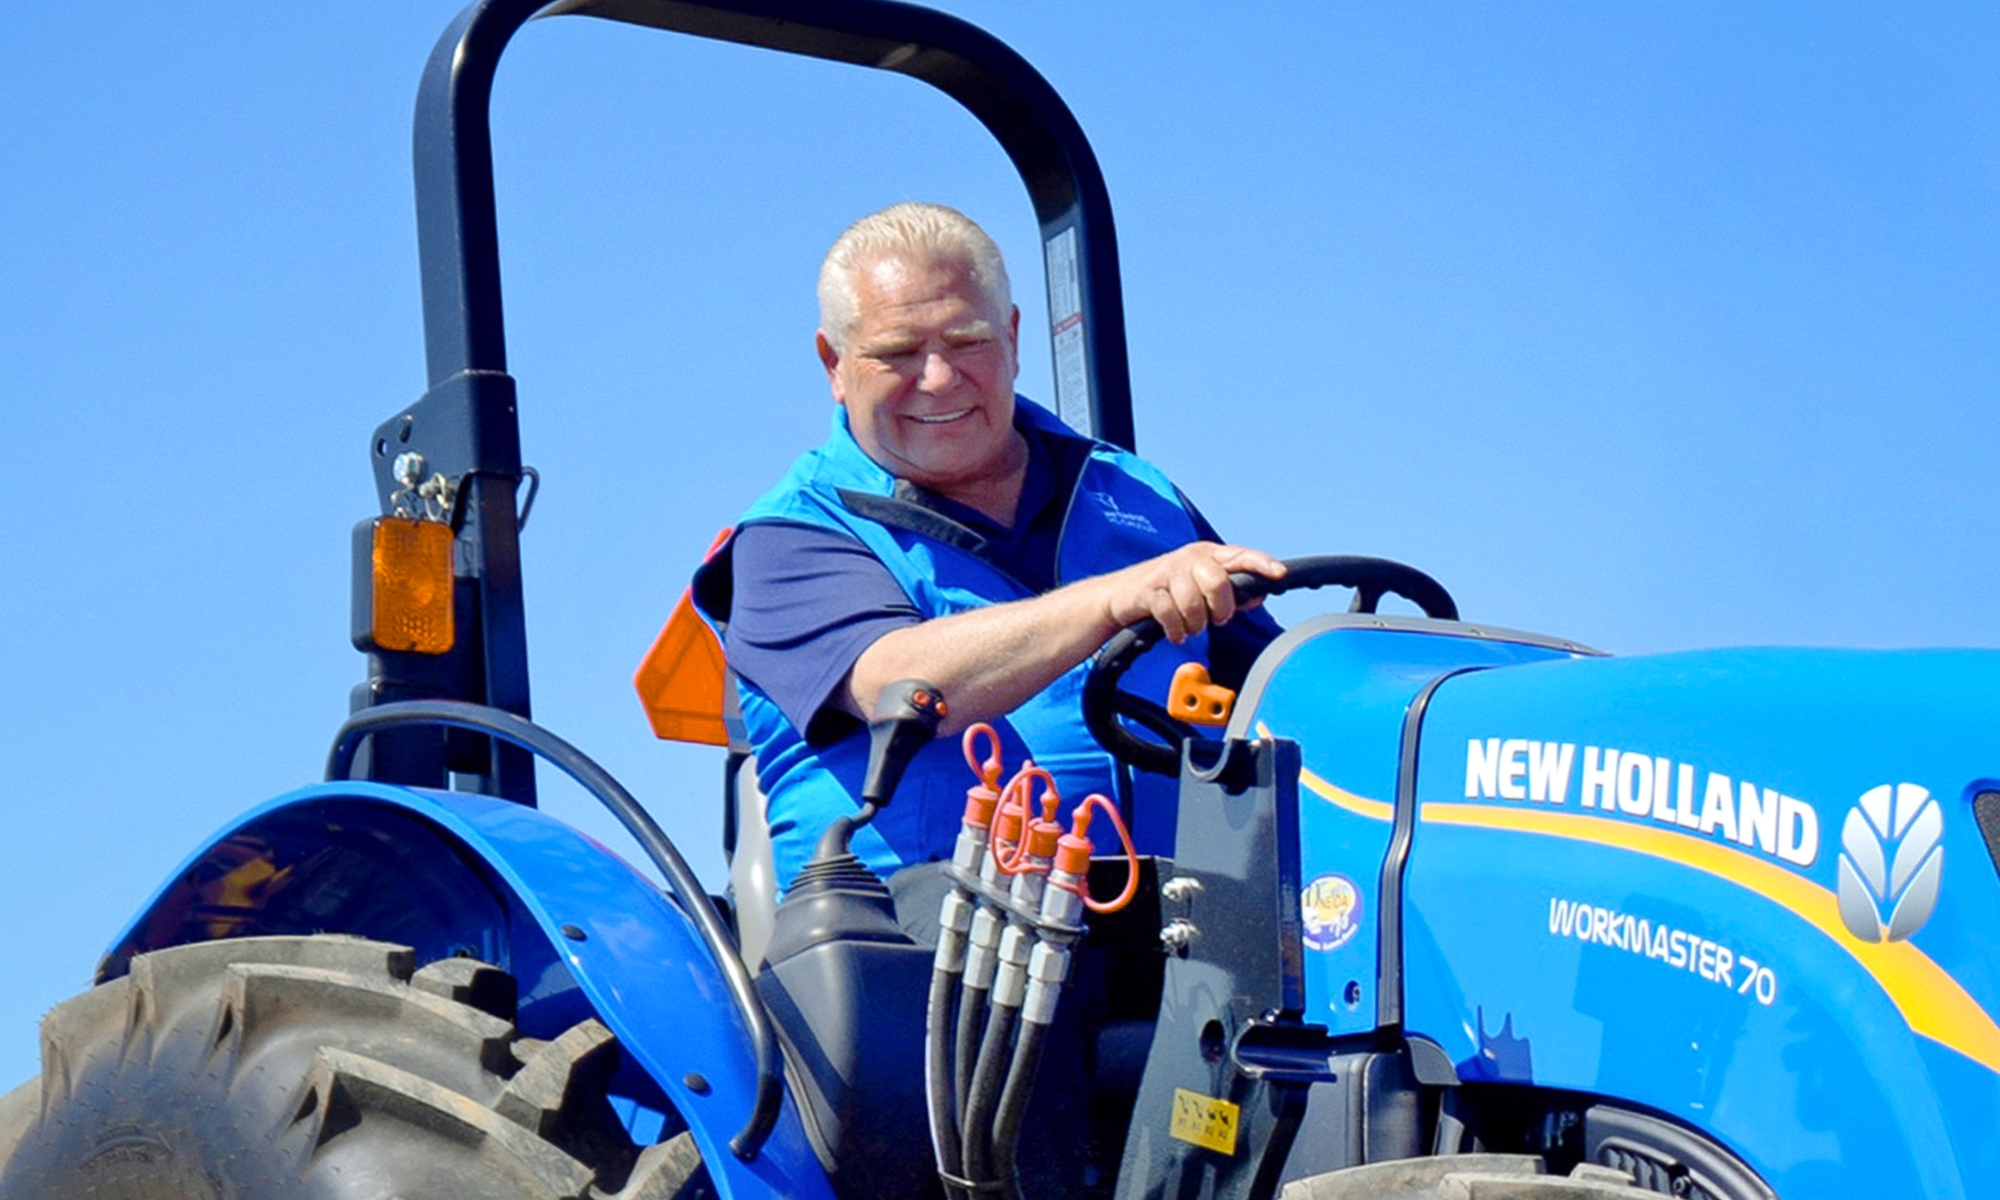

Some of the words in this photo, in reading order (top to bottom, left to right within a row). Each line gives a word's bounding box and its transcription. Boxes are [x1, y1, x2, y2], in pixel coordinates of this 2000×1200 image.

[1465, 738, 1575, 804] NEW
[1581, 746, 1819, 867] HOLLAND
[1549, 897, 1734, 988] WORKMASTER
[1738, 955, 1777, 1006] 70
